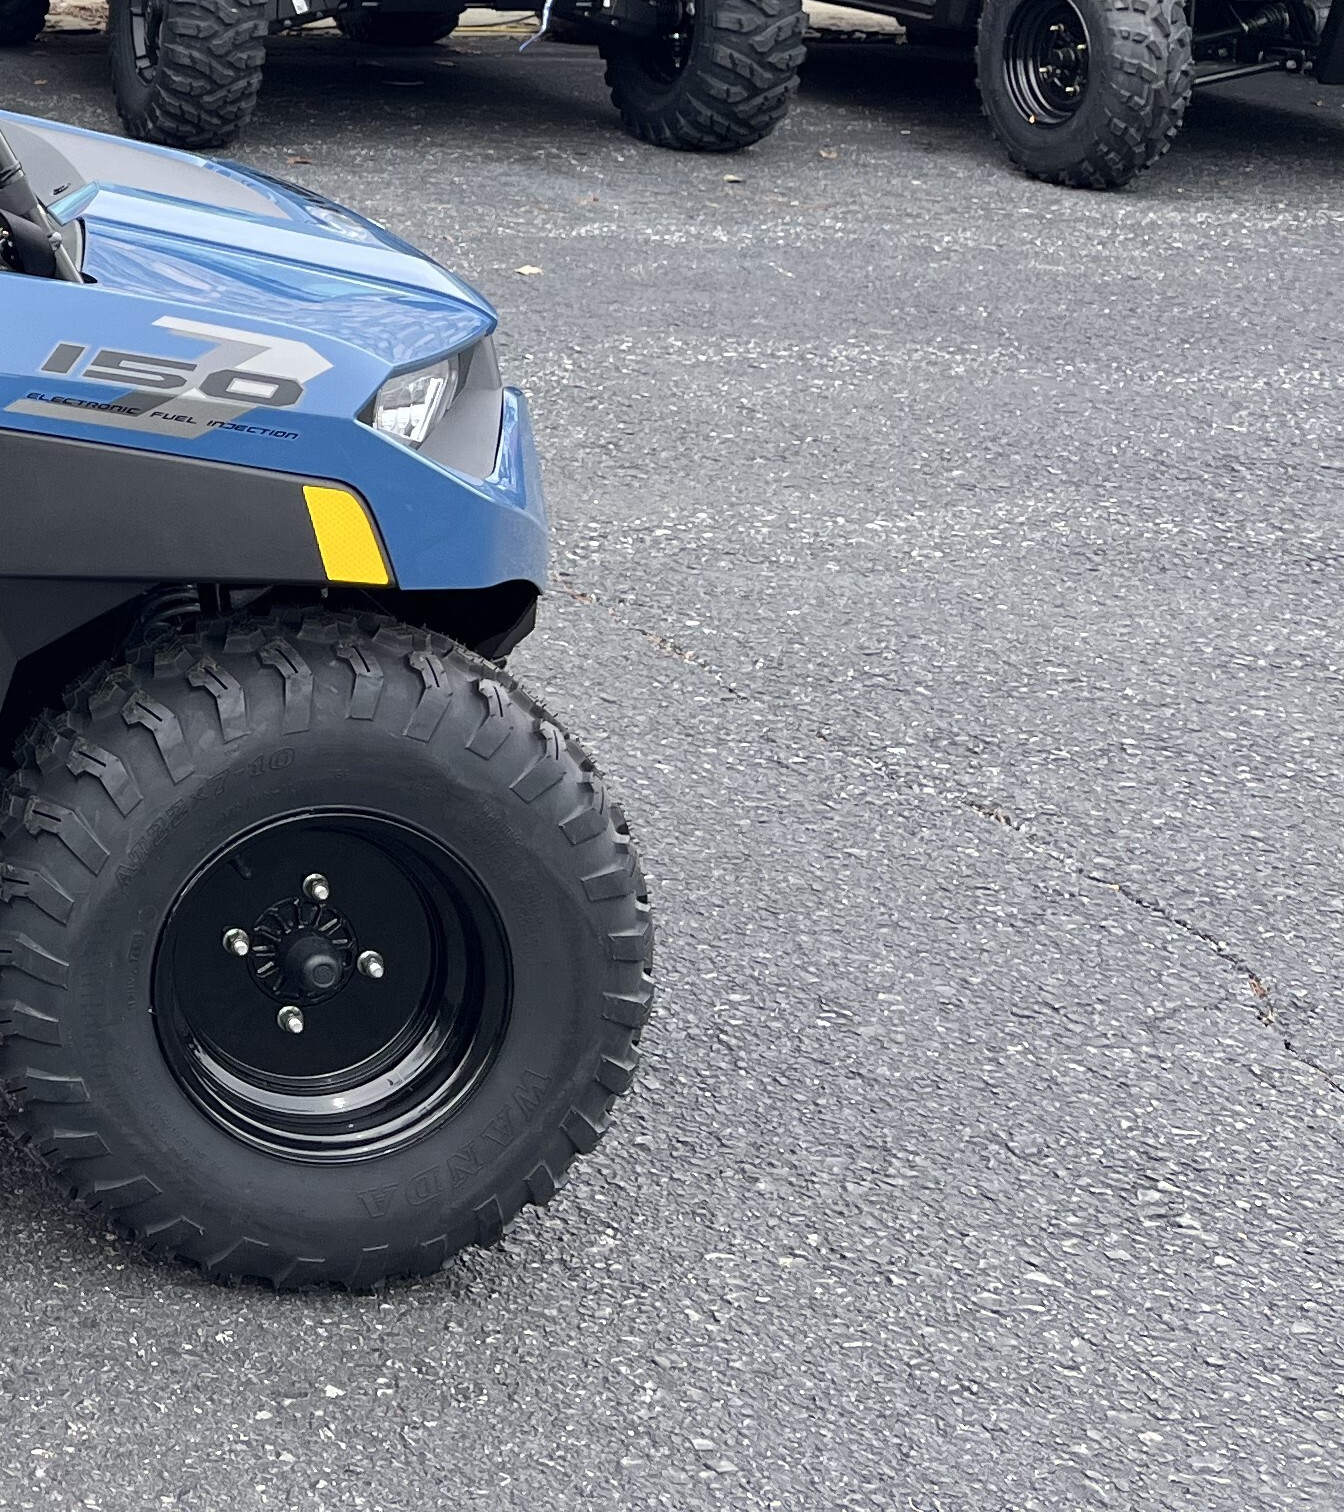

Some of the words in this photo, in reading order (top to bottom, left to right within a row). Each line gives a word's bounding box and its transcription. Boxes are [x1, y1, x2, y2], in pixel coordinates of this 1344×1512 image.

[41, 343, 304, 408] 150
[26, 392, 141, 416] ELECTRONIC
[149, 410, 198, 425] FUEL
[206, 419, 299, 440] INJECTION
[357, 1066, 552, 1219] WANDA
